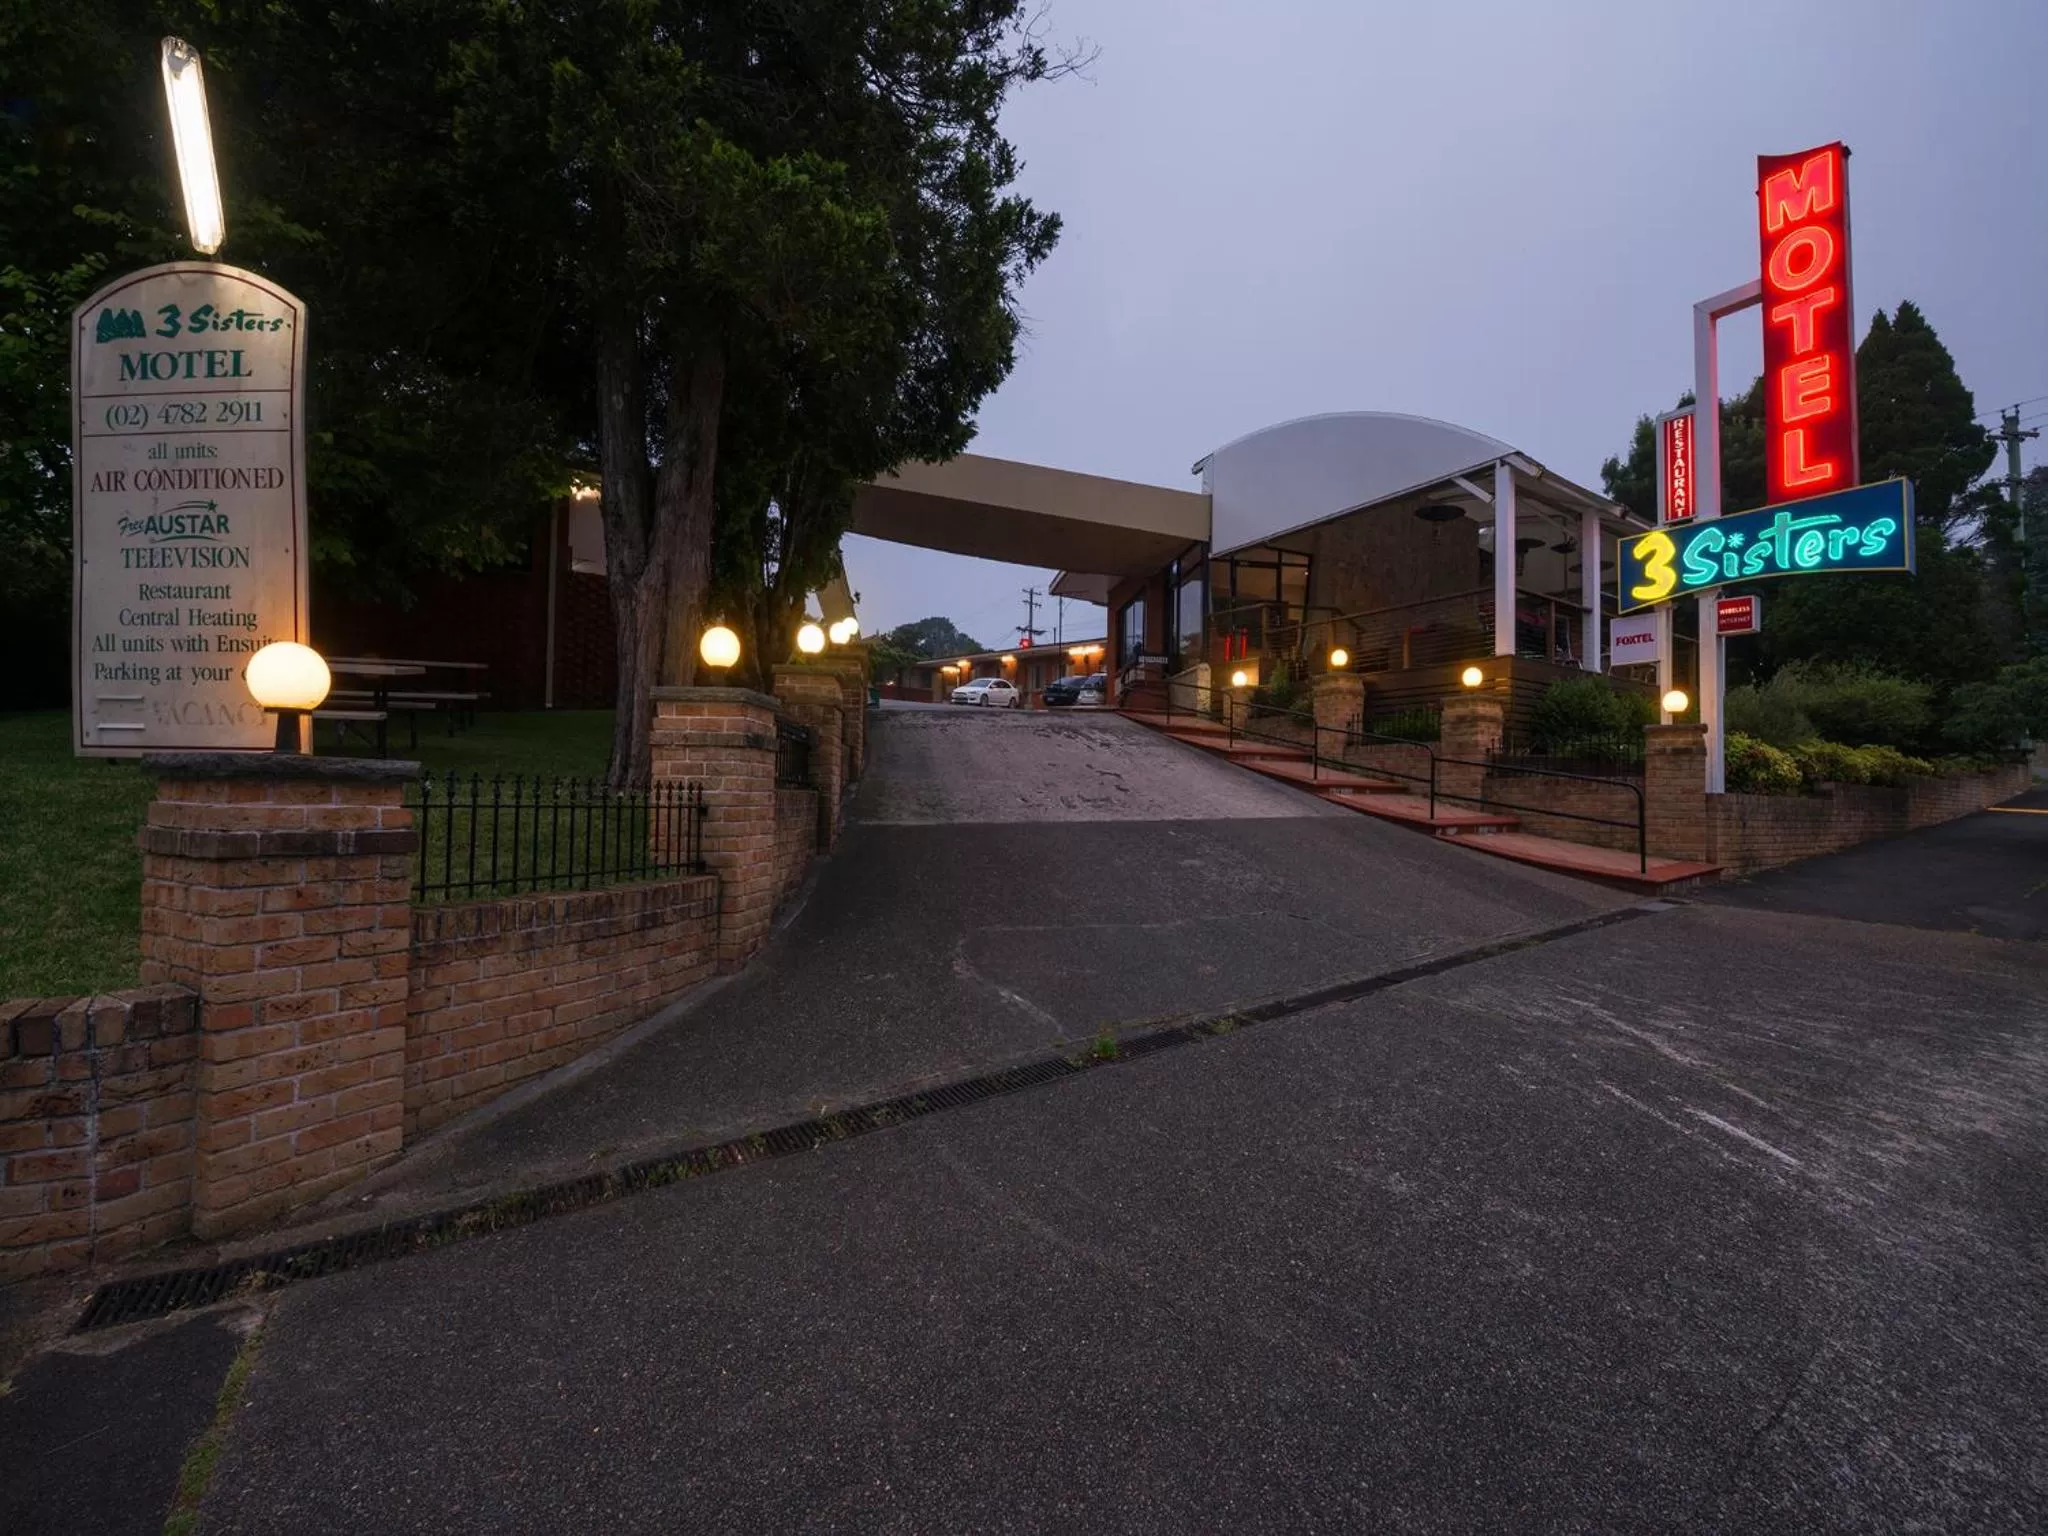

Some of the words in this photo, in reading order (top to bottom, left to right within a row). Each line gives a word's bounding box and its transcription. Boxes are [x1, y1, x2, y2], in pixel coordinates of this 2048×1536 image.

[156, 304, 182, 338] 3
[188, 304, 284, 334] Sisters
[1764, 150, 1835, 488] MOTEL
[119, 350, 253, 381] MOTEL
[105, 403, 149, 431] (02)
[157, 401, 208, 425] 4782
[216, 401, 262, 425] 2911
[148, 442, 167, 460] all
[91, 469, 127, 493] AIR
[134, 467, 284, 490] CONDITIONED
[1673, 418, 1686, 518] RESTAURANT
[117, 516, 145, 536] Free
[144, 514, 230, 535] AUSTAR
[120, 547, 250, 569] TELEVISION
[1631, 530, 1677, 600] 3
[1683, 511, 1896, 585] Sisters
[139, 584, 231, 600] Restaurant
[119, 608, 179, 627] Central
[188, 608, 257, 632] Heating
[92, 633, 116, 652] All
[120, 635, 165, 652] units
[171, 634, 209, 652] with
[216, 633, 278, 652] Ensui
[1615, 632, 1655, 647] FOXTEL
[94, 662, 161, 686] Parking
[166, 663, 182, 681] at
[191, 667, 234, 686] your
